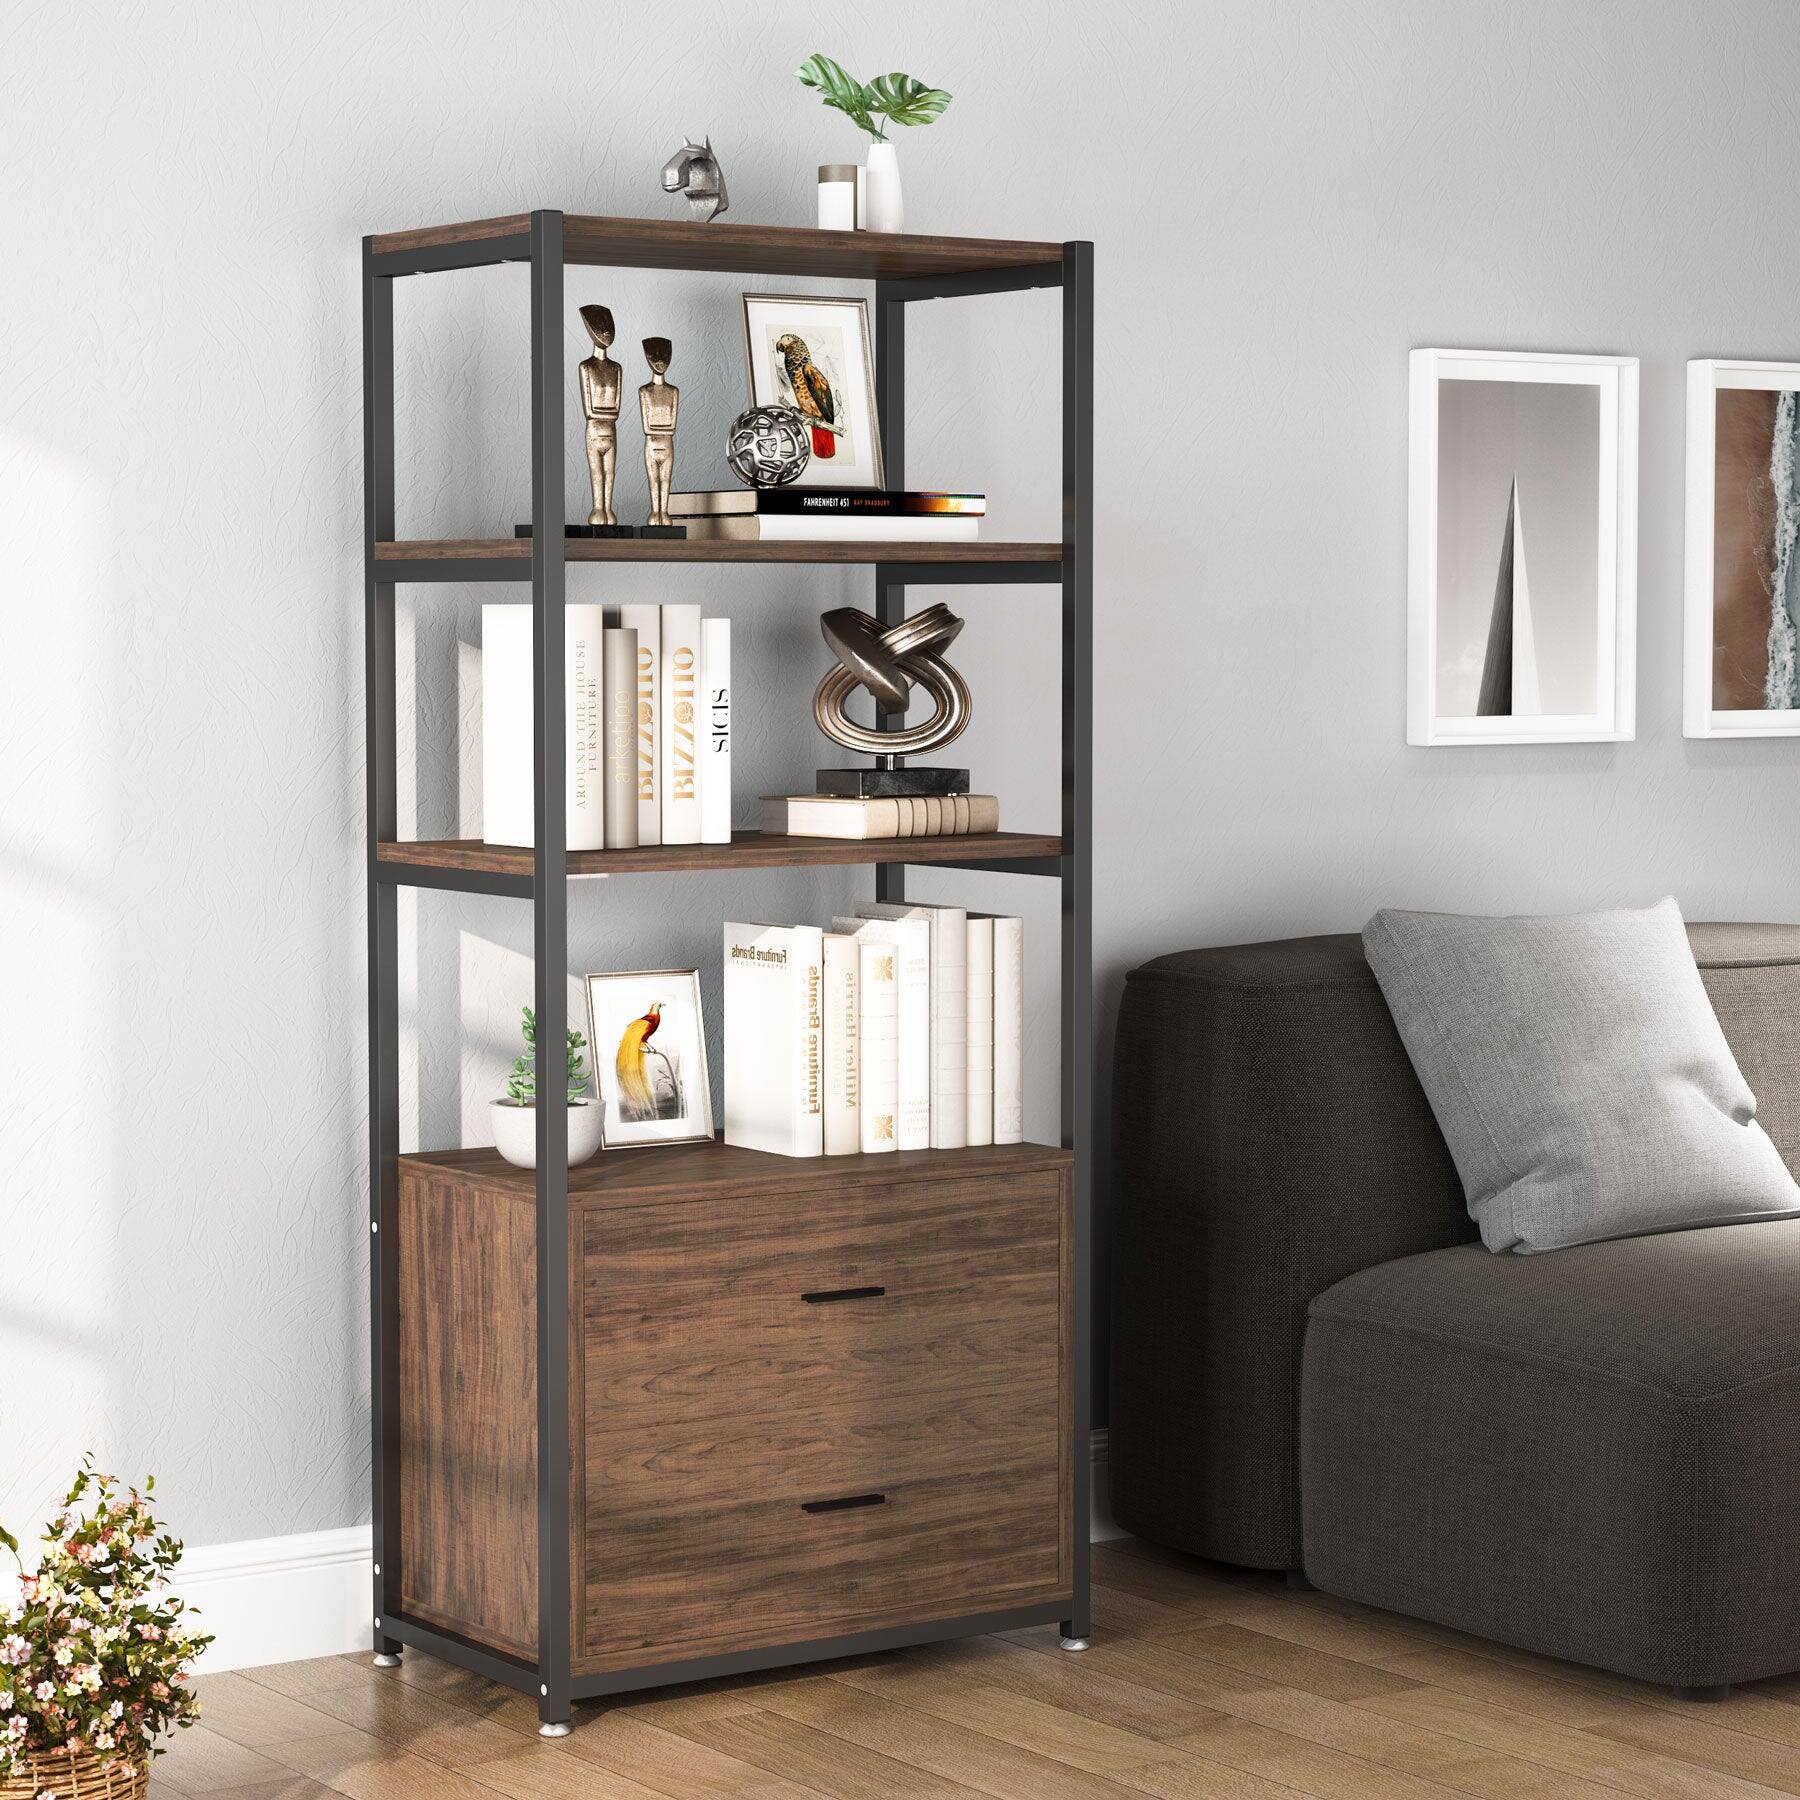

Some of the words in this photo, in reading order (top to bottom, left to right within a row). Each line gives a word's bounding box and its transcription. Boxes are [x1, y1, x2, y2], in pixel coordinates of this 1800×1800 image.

[803, 497, 839, 507] FAHRENHEIT
[840, 498, 850, 508] 451
[576, 640, 585, 694] HOUSE
[576, 702, 585, 734] THE
[588, 679, 597, 771] FURNITURE
[712, 688, 729, 753] SICIS
[576, 741, 586, 809] AROUND
